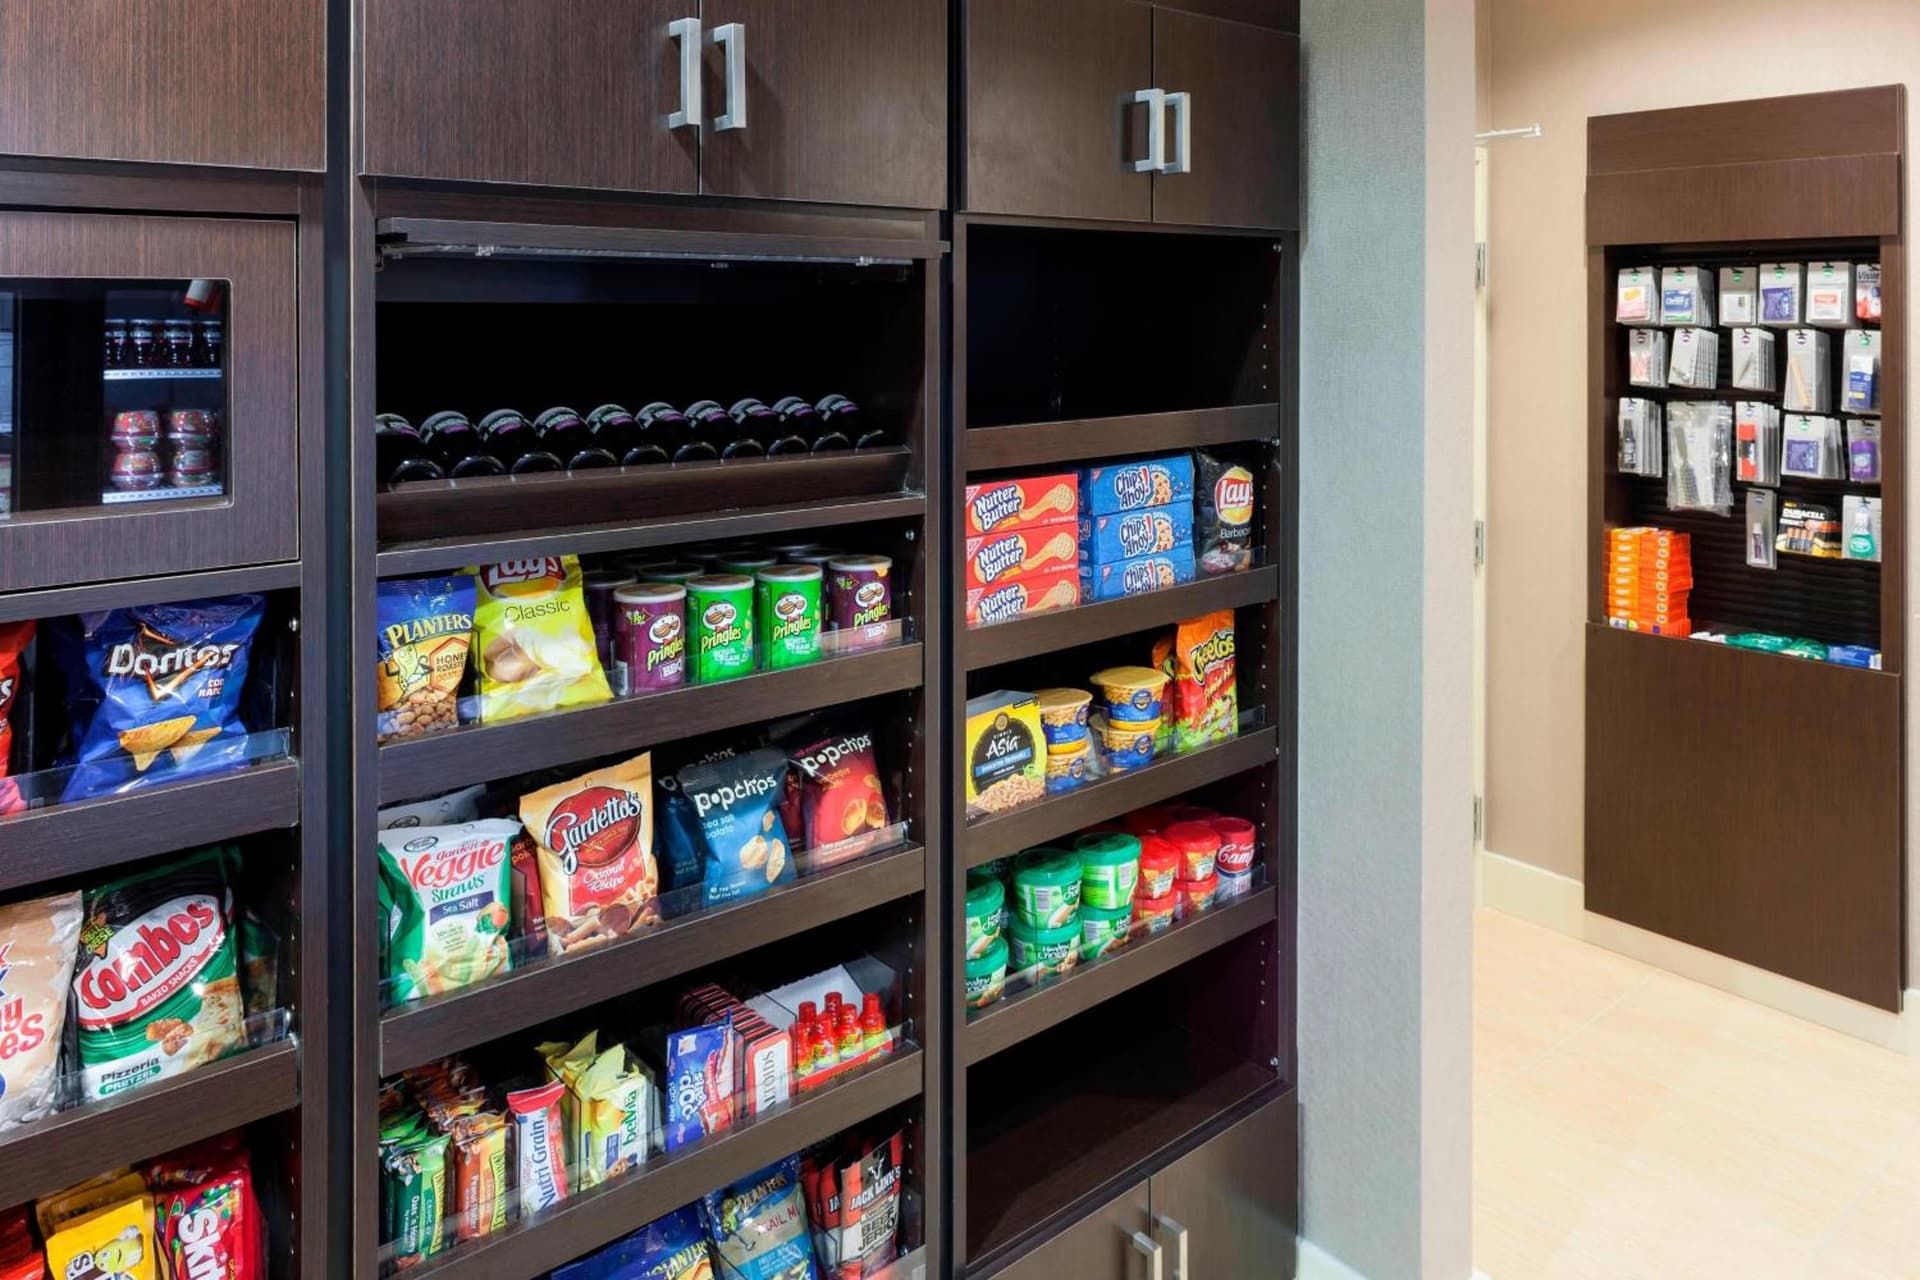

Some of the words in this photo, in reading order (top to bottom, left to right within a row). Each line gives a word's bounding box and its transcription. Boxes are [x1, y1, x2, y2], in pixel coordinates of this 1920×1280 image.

[1116, 470, 1143, 496] Chips
[975, 485, 1016, 513] Nutter
[982, 498, 1021, 531] Butter
[1120, 517, 1147, 543] Chips
[978, 536, 1018, 567] Nutter
[985, 548, 1023, 582] Butter
[1125, 565, 1150, 591] Chips
[504, 599, 570, 622] Classic
[979, 584, 1019, 617] Nutter
[773, 616, 812, 642] Pringles
[854, 603, 889, 632] Pringles
[386, 614, 472, 651] PLANTERS
[701, 626, 742, 654] Pringles
[108, 643, 241, 675] Doritos
[800, 734, 872, 778] popchips
[985, 736, 1019, 759] Asia
[694, 775, 777, 818] popchips
[544, 791, 642, 876] Gardetto's
[400, 841, 505, 890] Veggie
[583, 859, 625, 885] Original
[431, 874, 485, 903] Straws
[587, 876, 625, 894] Recipe
[442, 903, 458, 913] Sea
[459, 898, 479, 910] Salt
[86, 926, 115, 954] CHEESE
[81, 903, 214, 1010] Combos
[140, 984, 169, 1006] BAKED
[169, 956, 198, 987] SNACKS
[100, 1056, 160, 1084] Pizzeria
[104, 1067, 158, 1094] PRETZEL
[621, 1089, 638, 1146] belVita
[530, 1119, 548, 1164] Grain
[737, 1174, 787, 1214] PLANTER
[850, 1185, 874, 1212] JACK
[874, 1166, 901, 1195] LINK'S
[411, 1195, 420, 1214] Oats
[829, 1195, 841, 1214] JA
[858, 1217, 896, 1251] JERKY
[861, 1206, 895, 1236] BEEF
